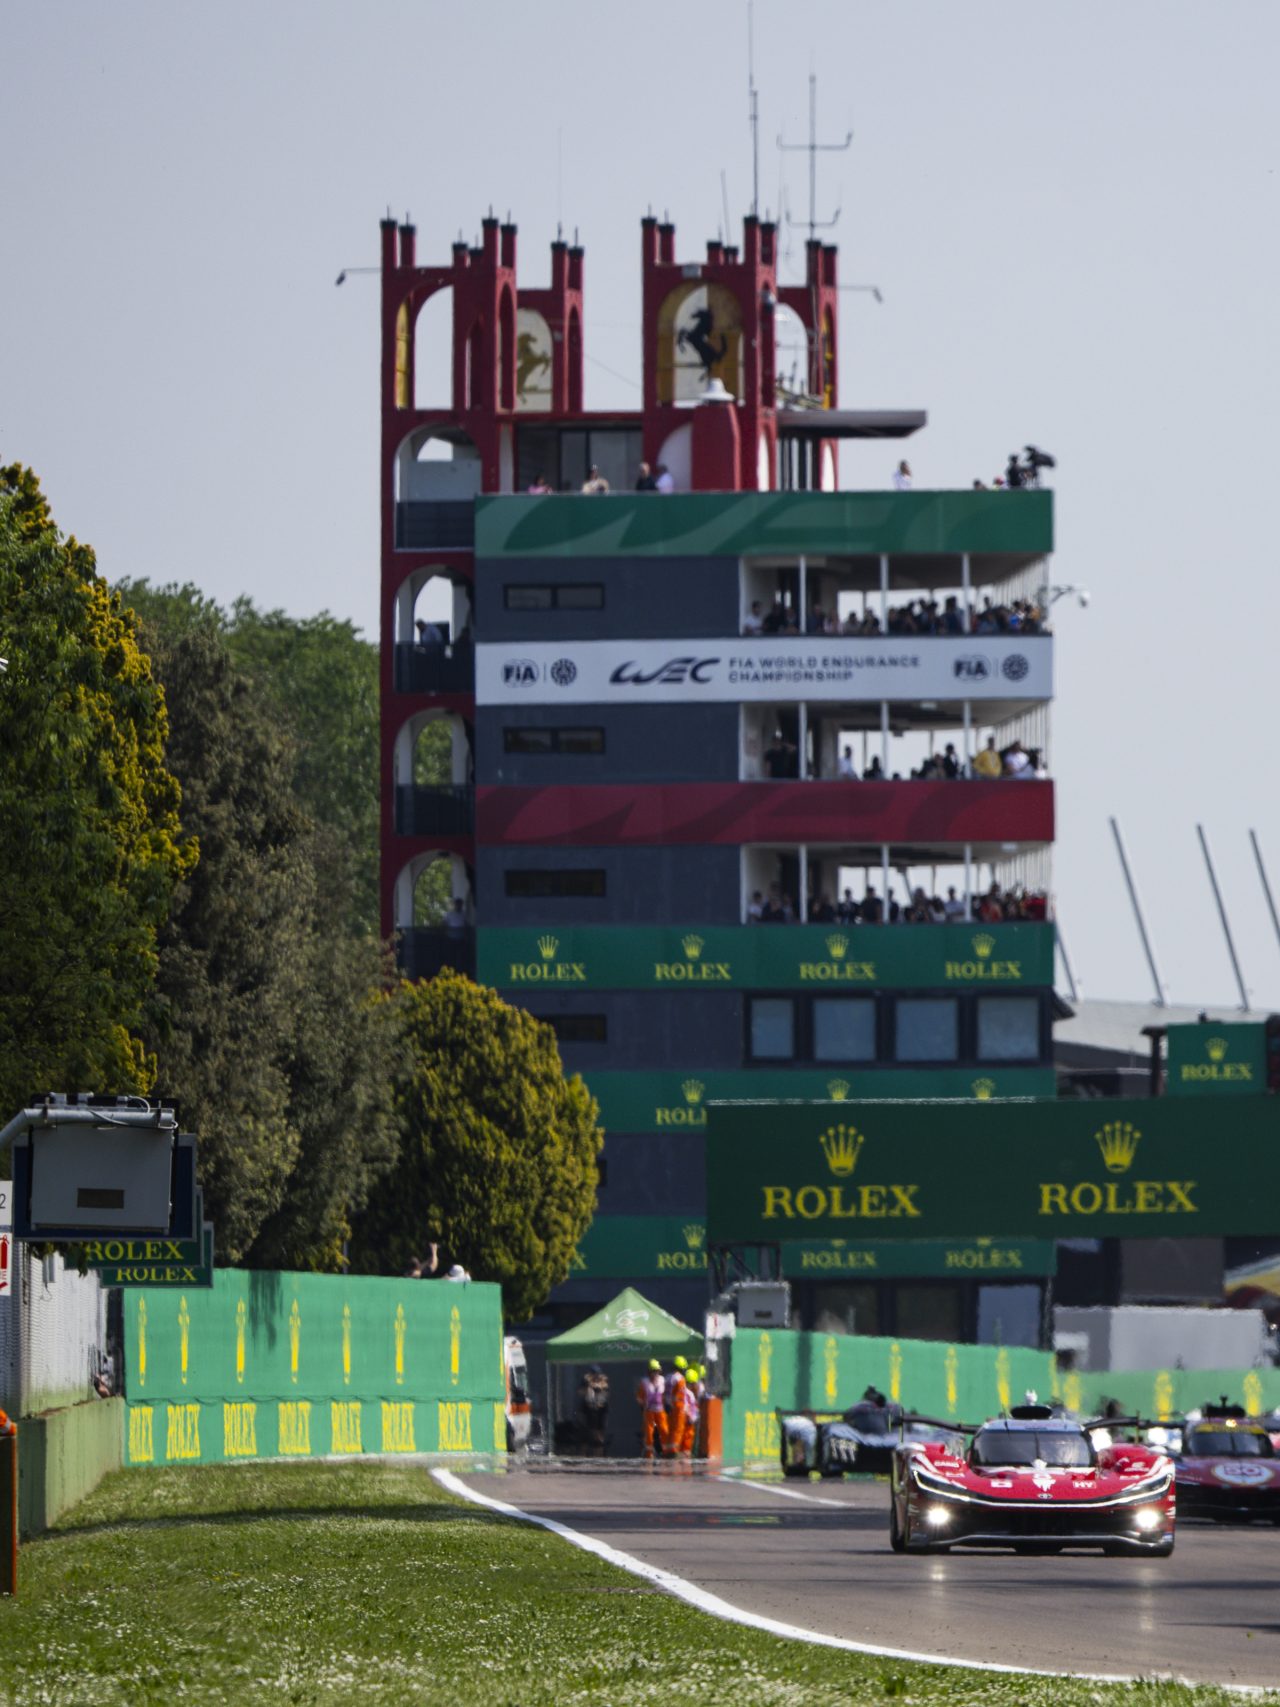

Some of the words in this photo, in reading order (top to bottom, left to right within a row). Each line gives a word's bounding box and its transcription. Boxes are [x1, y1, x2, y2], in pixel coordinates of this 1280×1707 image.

[609, 657, 721, 684] WEC
[729, 657, 753, 669] FIA
[759, 657, 816, 669] WORLD
[822, 656, 920, 668] ENDURANCE
[953, 659, 988, 678] FIA
[503, 665, 538, 683] FIA
[729, 671, 853, 682] CHAMPIONSHIP
[511, 963, 586, 981] ROLEX
[655, 963, 731, 980] ROLEX
[800, 962, 876, 980] ROLEX
[946, 961, 1021, 979] ROLEX
[1181, 1062, 1253, 1081] ROLEX
[655, 1107, 707, 1126] ROL
[761, 1184, 921, 1219] ROLEX
[1038, 1181, 1199, 1215] ROLEX
[84, 1241, 184, 1261] ROLEX
[656, 1252, 708, 1269] ROL
[802, 1250, 878, 1269] ROLEX
[945, 1249, 1023, 1268] ROLEX
[115, 1267, 197, 1282] ROLEX
[166, 1404, 201, 1460] ROLEX
